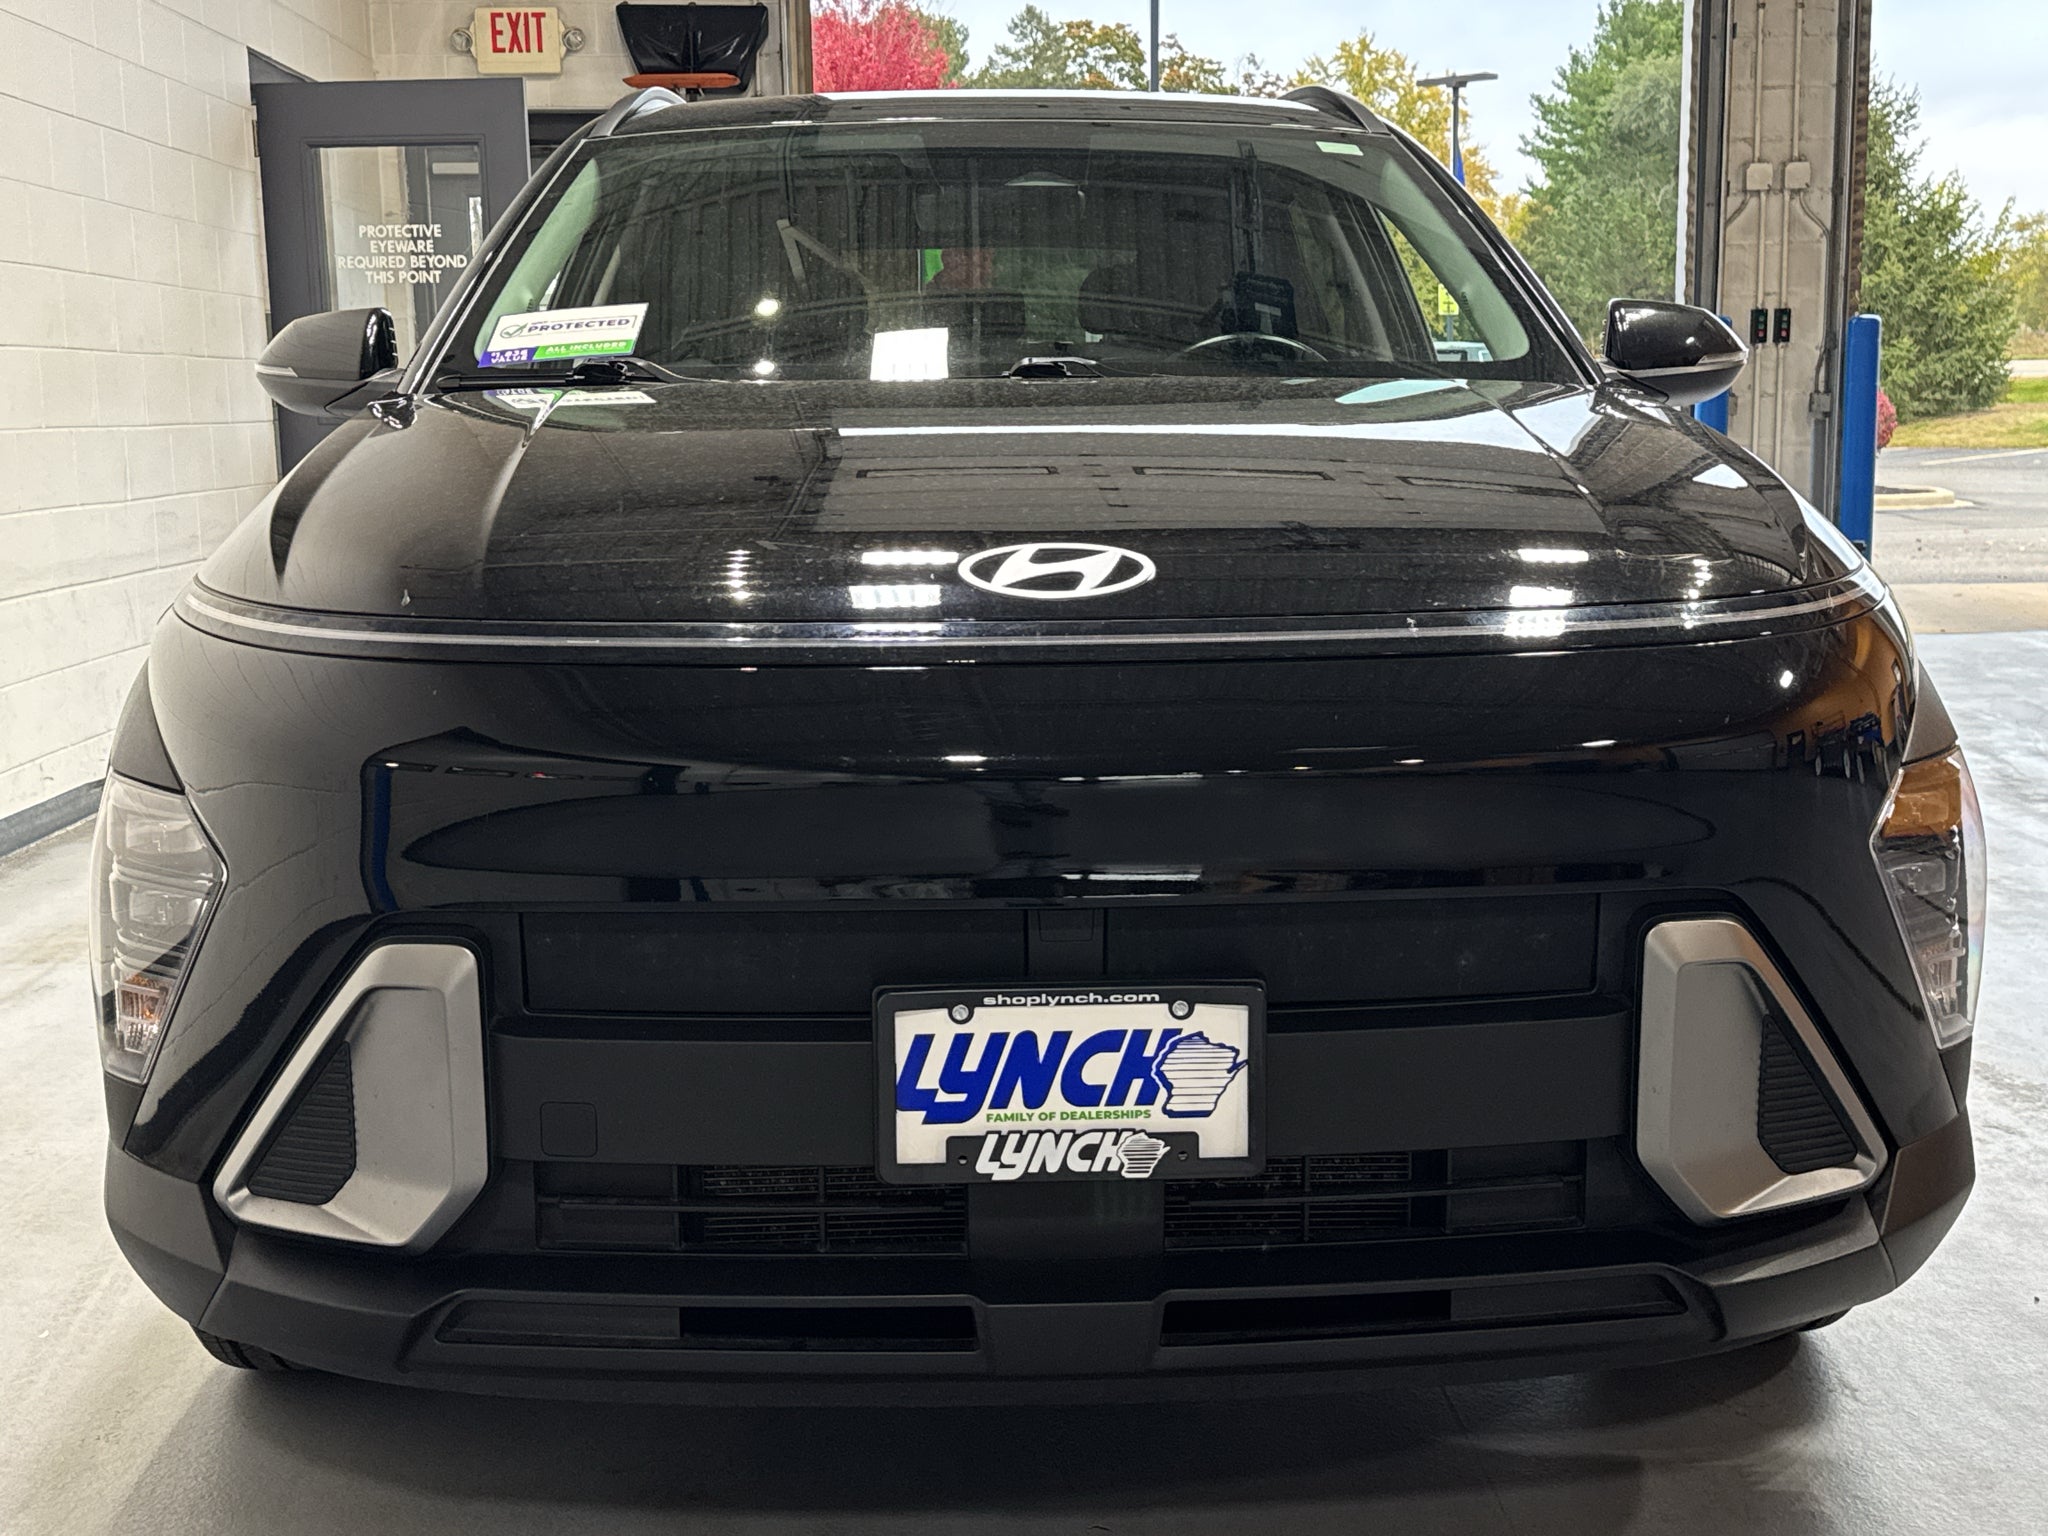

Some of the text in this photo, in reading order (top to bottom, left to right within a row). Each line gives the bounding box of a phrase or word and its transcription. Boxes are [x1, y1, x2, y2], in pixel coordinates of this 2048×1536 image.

[490, 12, 546, 53] EXIT
[358, 224, 442, 238] PROTECTIVE
[370, 240, 434, 253] EYEWARE
[337, 255, 467, 269] REQUIRED BEYOND
[365, 270, 442, 284] THIS POINT
[527, 318, 631, 333] PROTECTED
[546, 341, 627, 353] ALL INCLUDED
[983, 992, 1160, 1007] shoplynch.com
[896, 1028, 1182, 1124] LYNCH
[986, 1109, 1152, 1122] FAMILY OF DEALERSHIPS
[974, 1131, 1135, 1180] LYNCH
